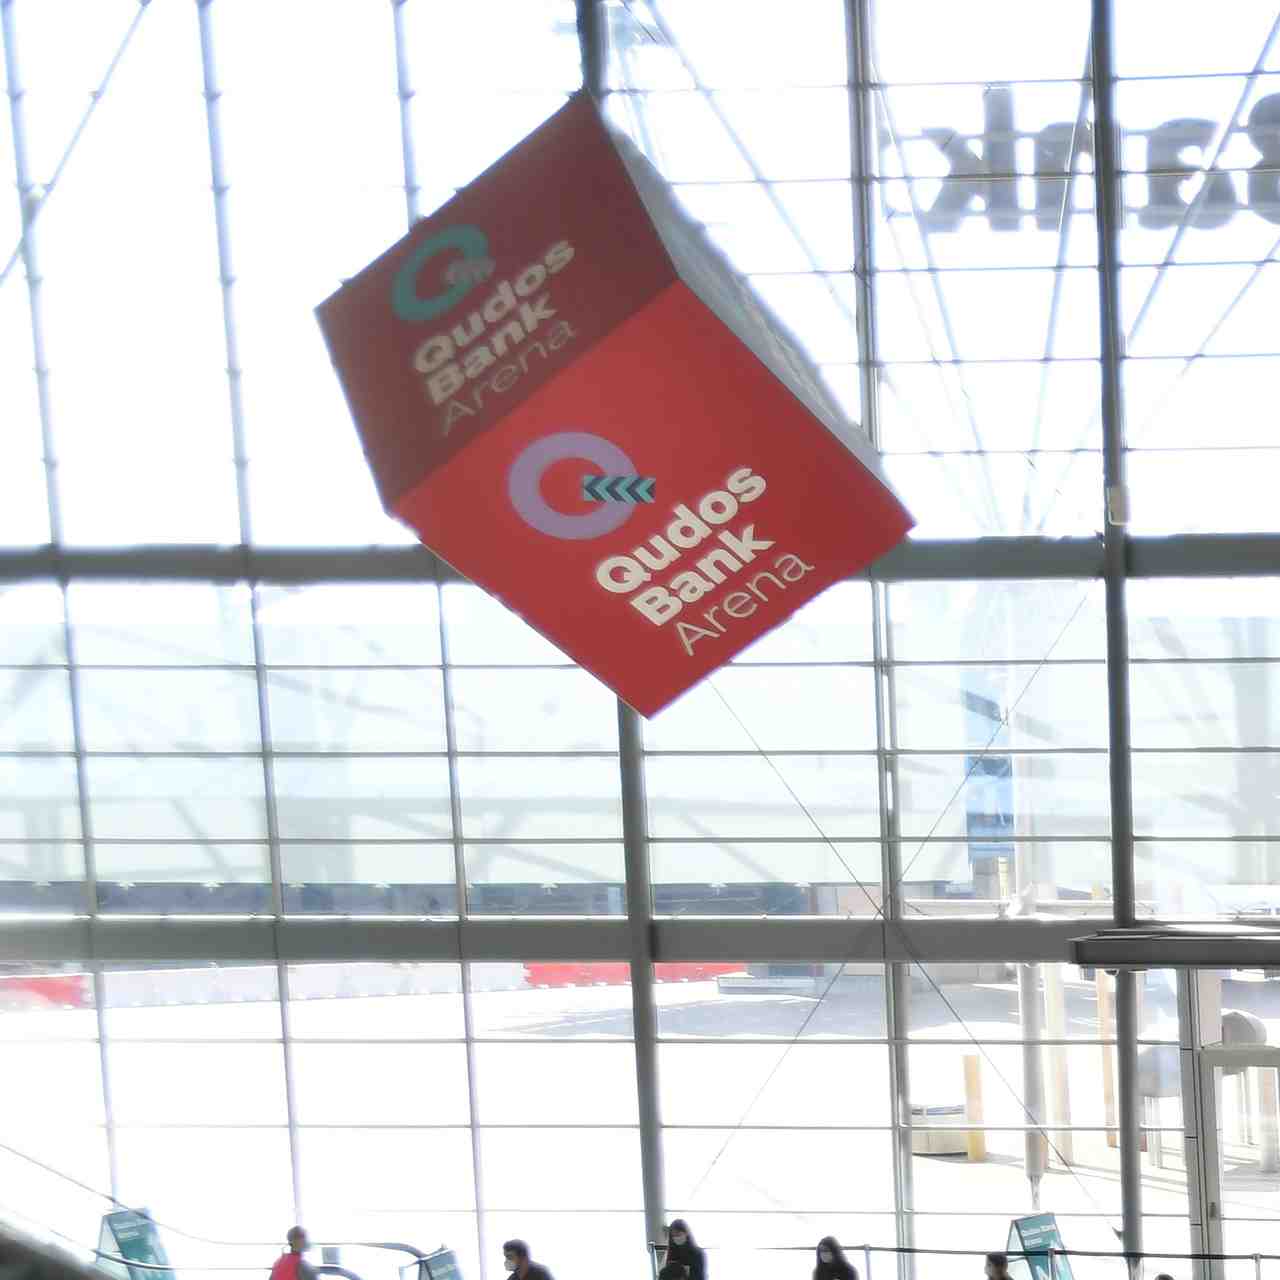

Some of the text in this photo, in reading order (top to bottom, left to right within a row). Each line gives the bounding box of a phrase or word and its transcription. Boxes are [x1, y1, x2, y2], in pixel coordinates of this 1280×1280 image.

[413, 240, 576, 374] Qudos
[428, 293, 558, 405] Bank
[443, 320, 577, 437] Arena
[596, 468, 767, 593] Qudos
[629, 523, 776, 626] Bank
[676, 553, 815, 656] Arena
